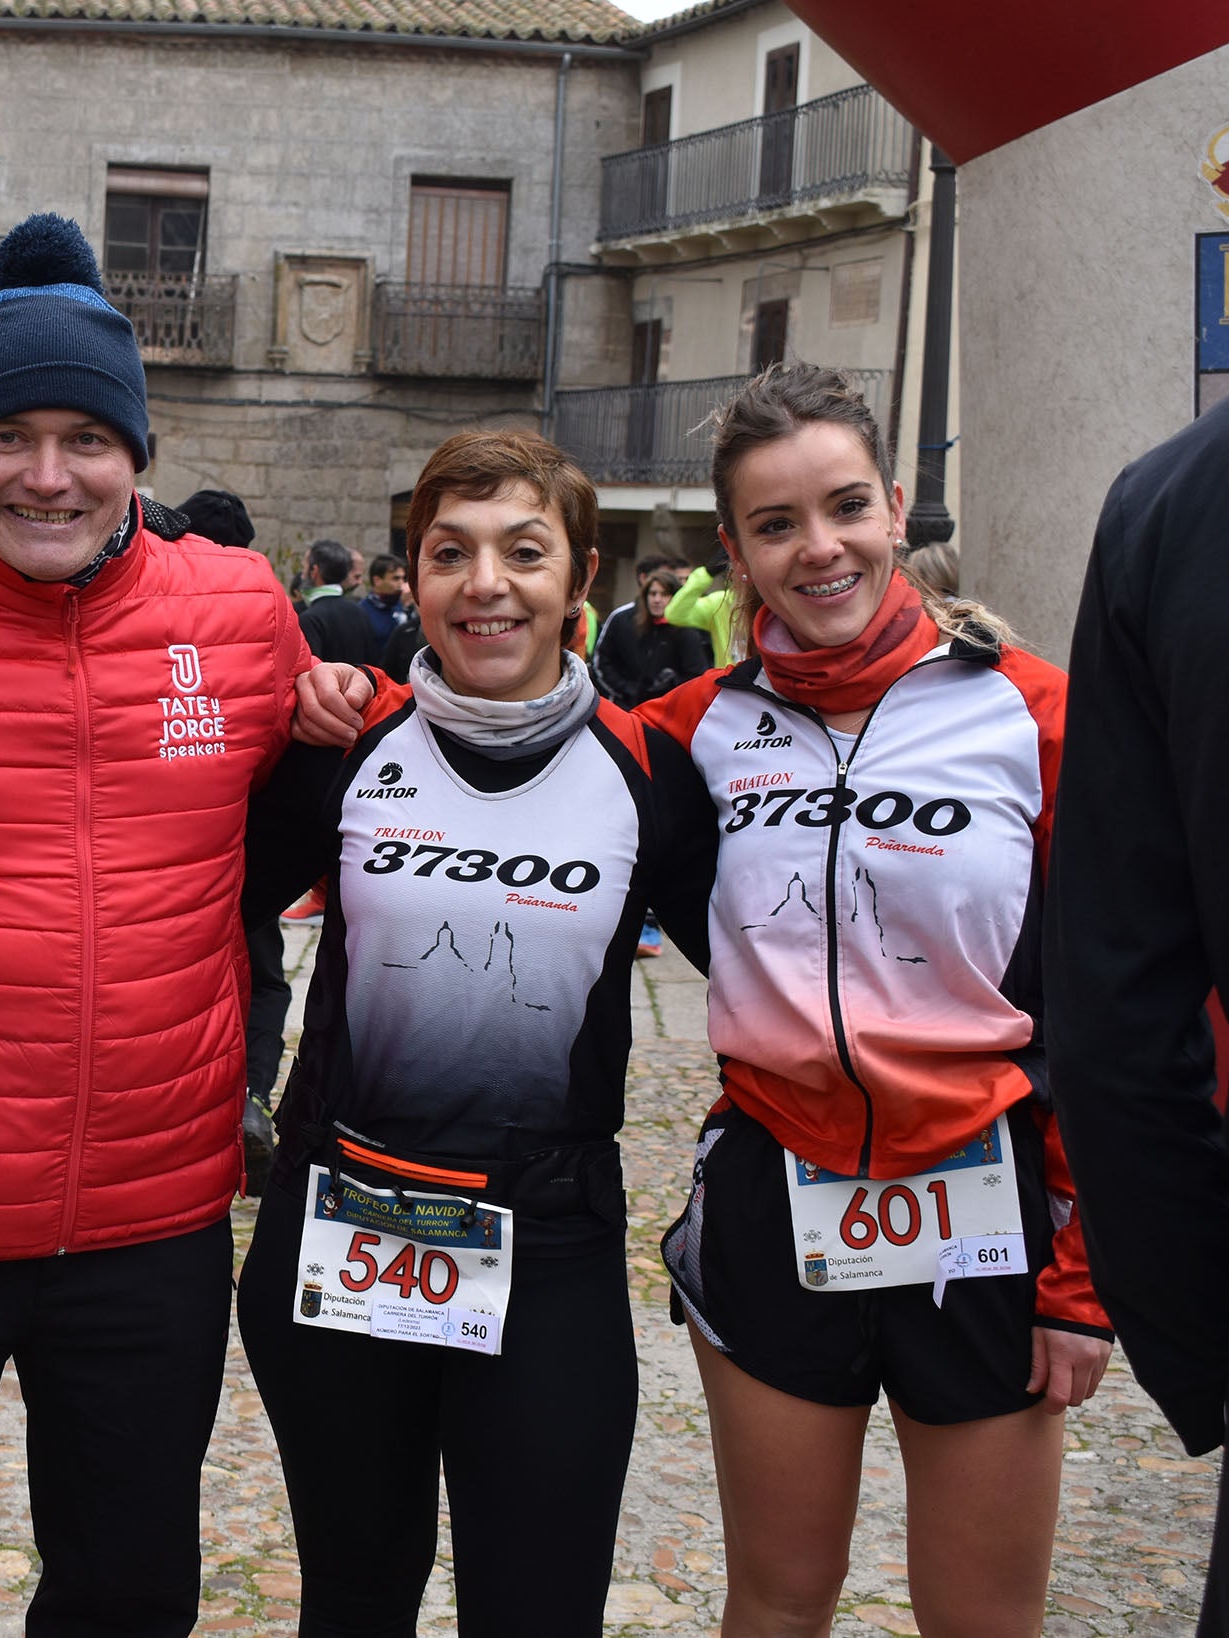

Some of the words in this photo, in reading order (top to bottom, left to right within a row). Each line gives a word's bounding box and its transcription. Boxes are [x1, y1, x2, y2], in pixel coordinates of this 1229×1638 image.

[158, 696, 209, 717] TATE
[159, 717, 225, 745] JORGE
[159, 741, 225, 762] speakers
[734, 735, 792, 751] VIATOR
[728, 772, 794, 794] TRIATLON
[356, 787, 418, 799] VIATOR
[724, 787, 971, 836] 37300
[373, 827, 445, 842] TRIATLON
[865, 836, 945, 857] Peñaranda
[363, 840, 600, 894] 37300
[505, 893, 578, 912] Peñaranda
[342, 1187, 389, 1213] TROFEO
[415, 1204, 466, 1217] NAVIDA
[840, 1179, 951, 1250] 601
[411, 1228, 467, 1238] SALAMANCA
[828, 1255, 873, 1266] Diputación
[978, 1247, 1008, 1263] 601
[339, 1231, 459, 1305] 540
[840, 1270, 883, 1280] Salamanca
[323, 1292, 365, 1306] Diputación
[321, 1308, 329, 1316] de
[331, 1308, 371, 1322] Salamanca
[461, 1322, 487, 1339] 540
